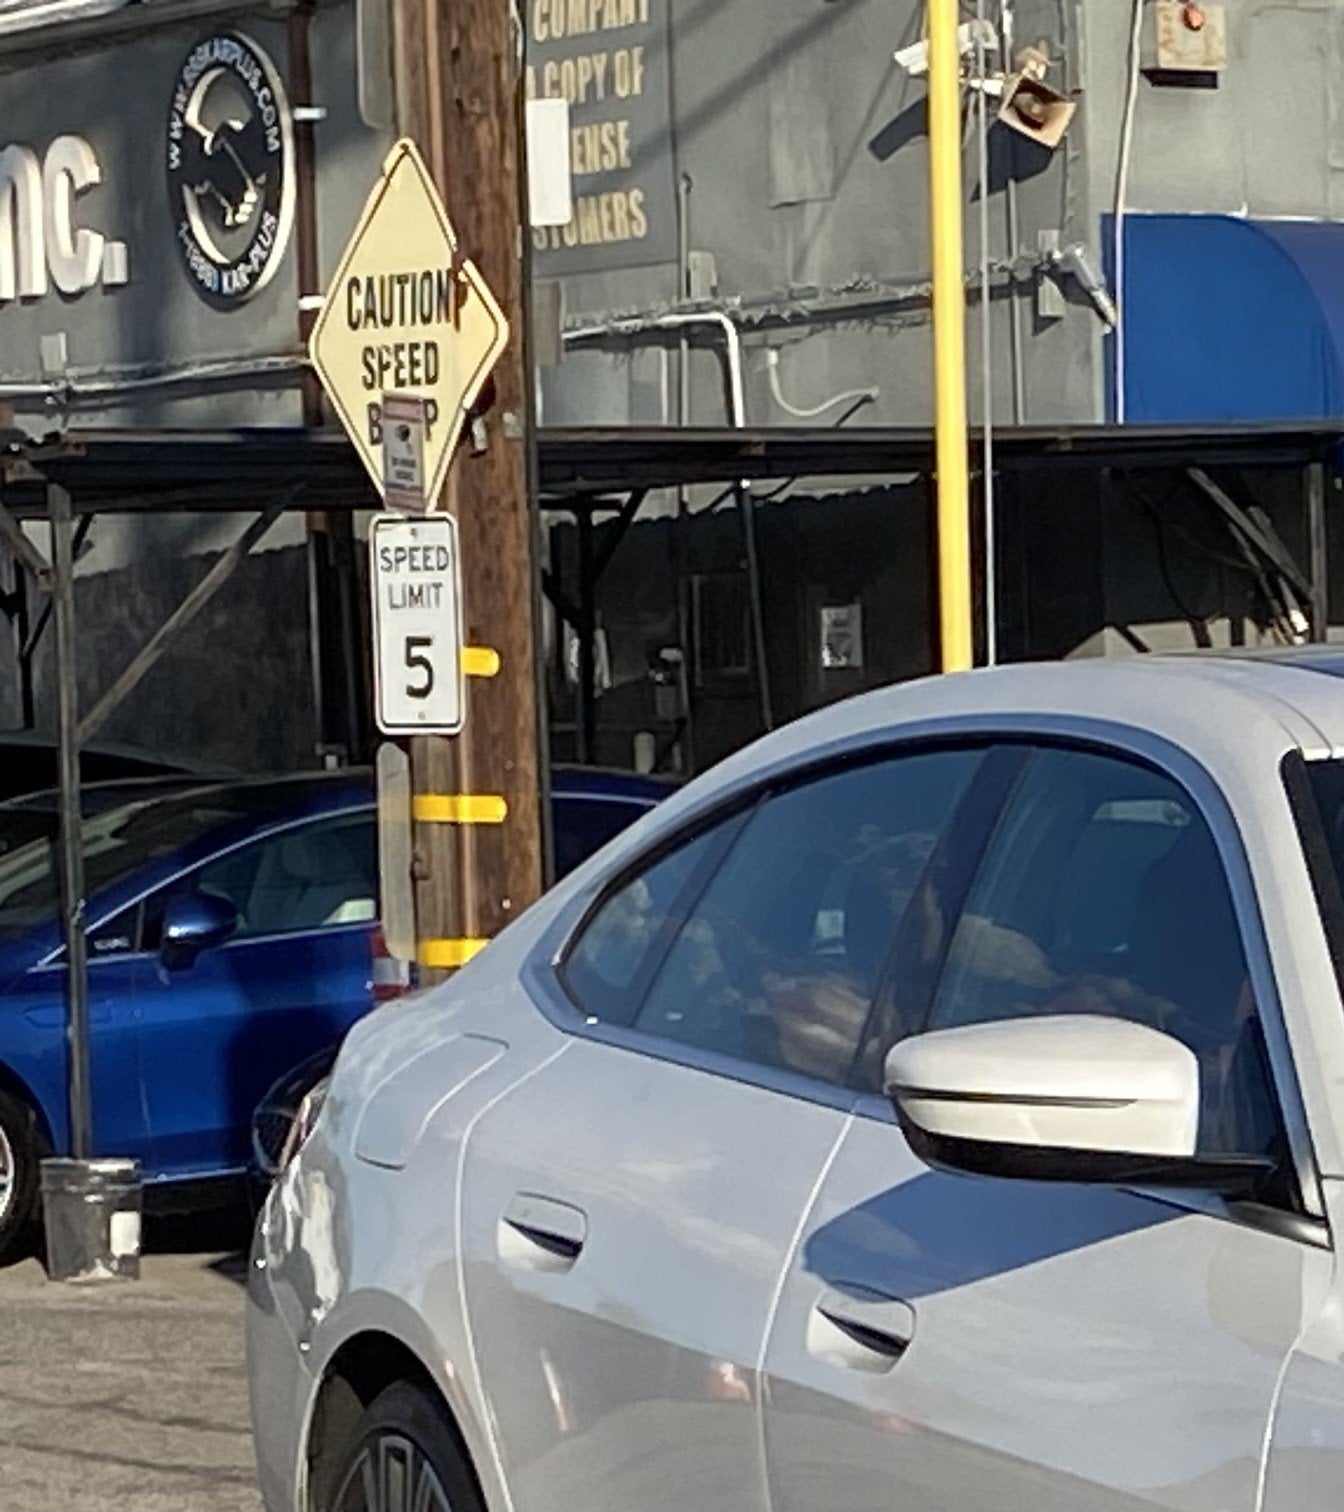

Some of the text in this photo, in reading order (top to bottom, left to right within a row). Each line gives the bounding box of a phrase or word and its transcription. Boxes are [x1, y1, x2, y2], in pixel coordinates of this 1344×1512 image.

[543, 52, 608, 105] COPY
[614, 46, 644, 98] OF
[572, 121, 630, 175] ENSE
[347, 267, 453, 331] CAUTION
[361, 341, 440, 390] SPEED
[367, 399, 439, 446] BP
[380, 545, 449, 573] SPEED
[387, 582, 443, 609] LIMIT
[405, 635, 434, 699] 5
